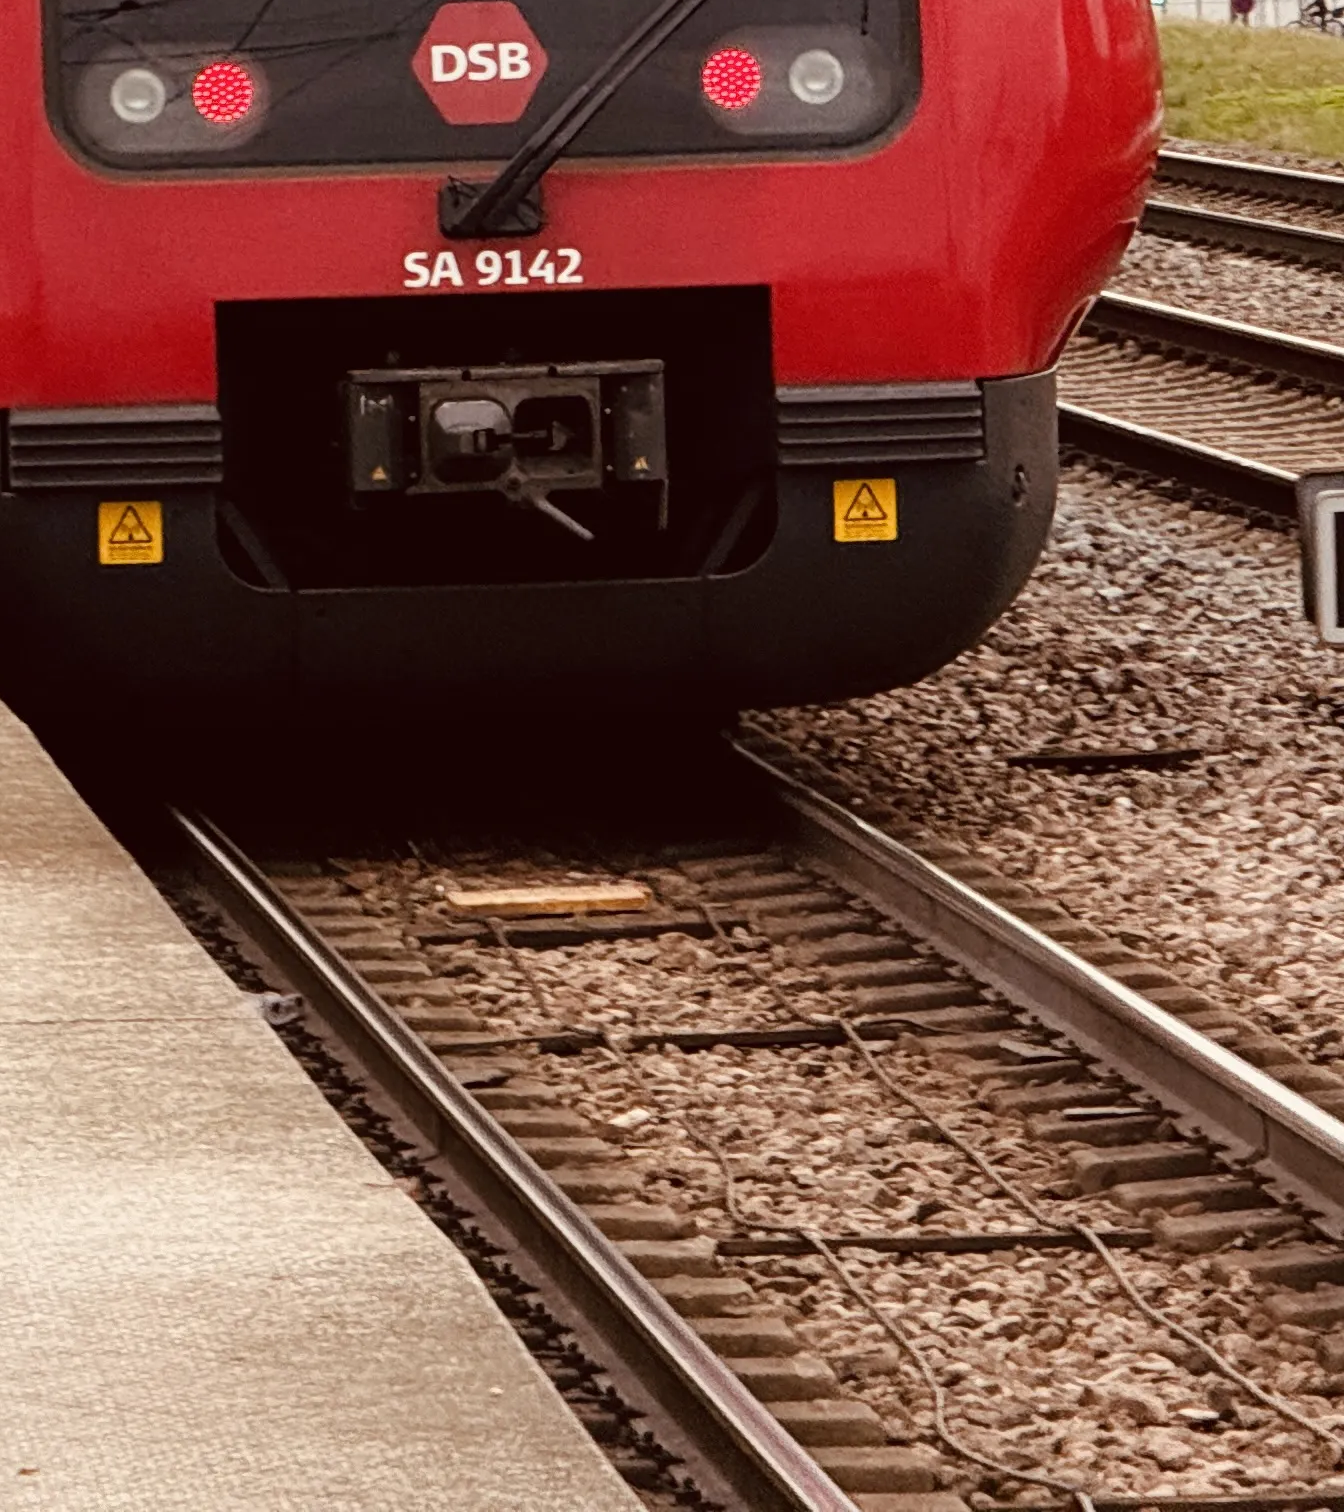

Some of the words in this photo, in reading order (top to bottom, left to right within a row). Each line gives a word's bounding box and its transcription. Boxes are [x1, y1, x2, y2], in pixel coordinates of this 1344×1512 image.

[431, 42, 532, 82] DSB
[403, 250, 465, 288] SA
[474, 247, 584, 286] 9142
